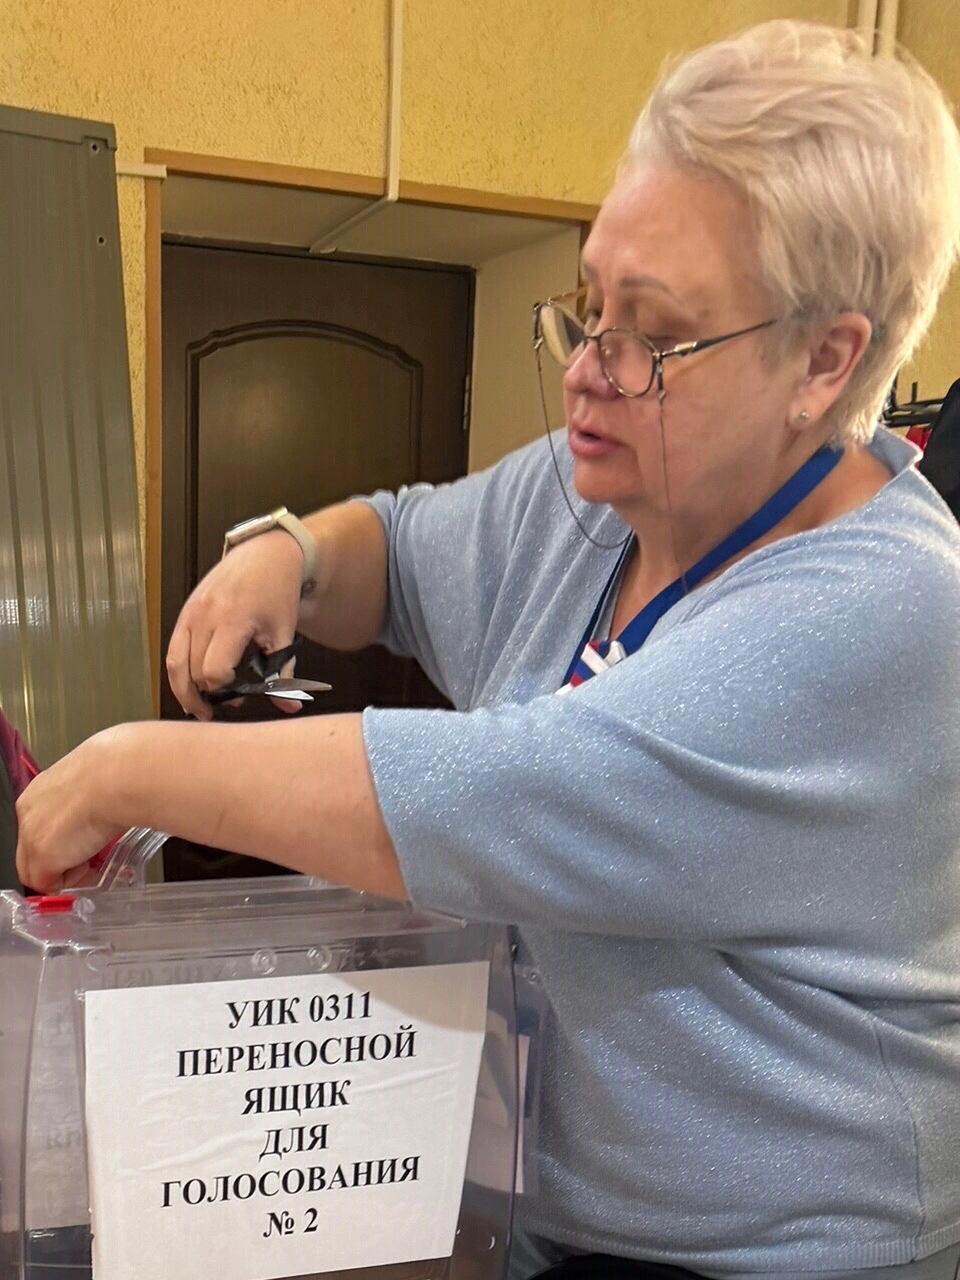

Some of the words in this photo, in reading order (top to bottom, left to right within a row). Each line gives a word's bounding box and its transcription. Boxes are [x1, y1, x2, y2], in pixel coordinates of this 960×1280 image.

[226, 996, 301, 1029] УИК
[309, 990, 373, 1022] 0311
[177, 1025, 418, 1078] ПЕРЕНОСНОЙ
[241, 1079, 351, 1117] ЯЩИК
[258, 1124, 330, 1162] ДЛЯ
[161, 1155, 421, 1208] ГОЛОСОВАНИЯ
[263, 1211, 296, 1238] №
[303, 1207, 319, 1233] 2
